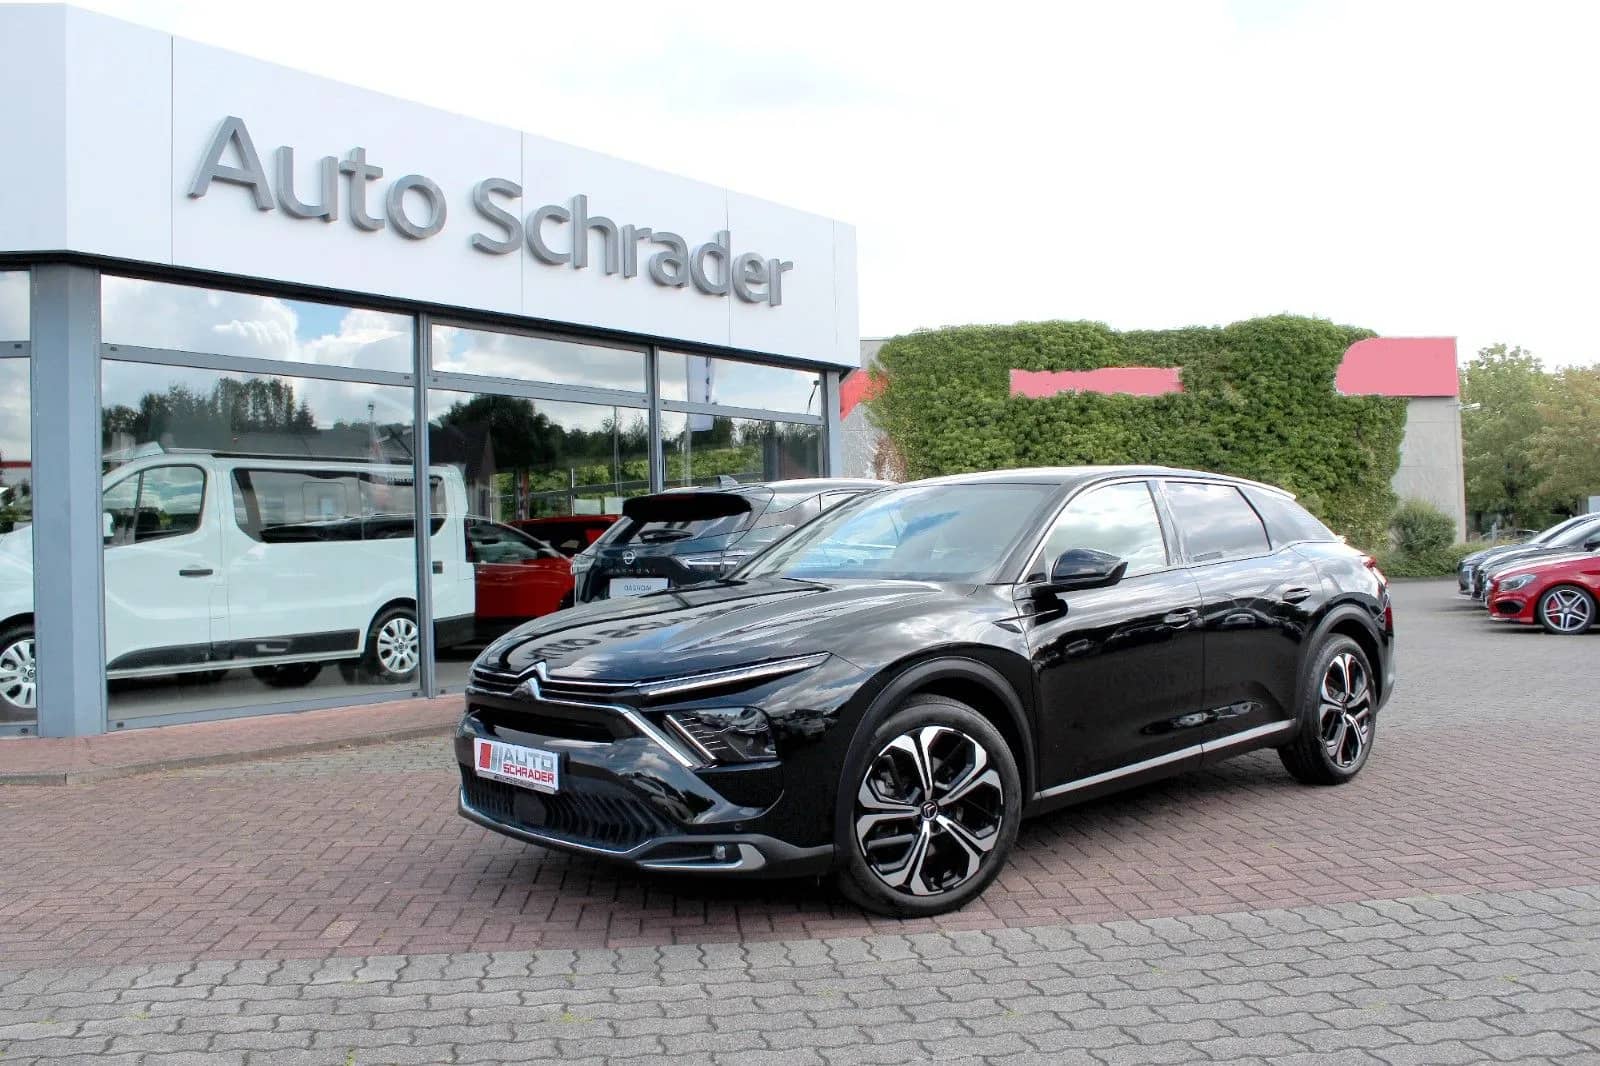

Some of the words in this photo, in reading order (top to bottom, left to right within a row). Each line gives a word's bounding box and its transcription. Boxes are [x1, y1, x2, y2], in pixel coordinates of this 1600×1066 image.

[187, 115, 447, 240] Auto
[471, 176, 793, 306] Schrader
[503, 746, 554, 771] AUTO
[503, 762, 555, 785] SCHRADER
